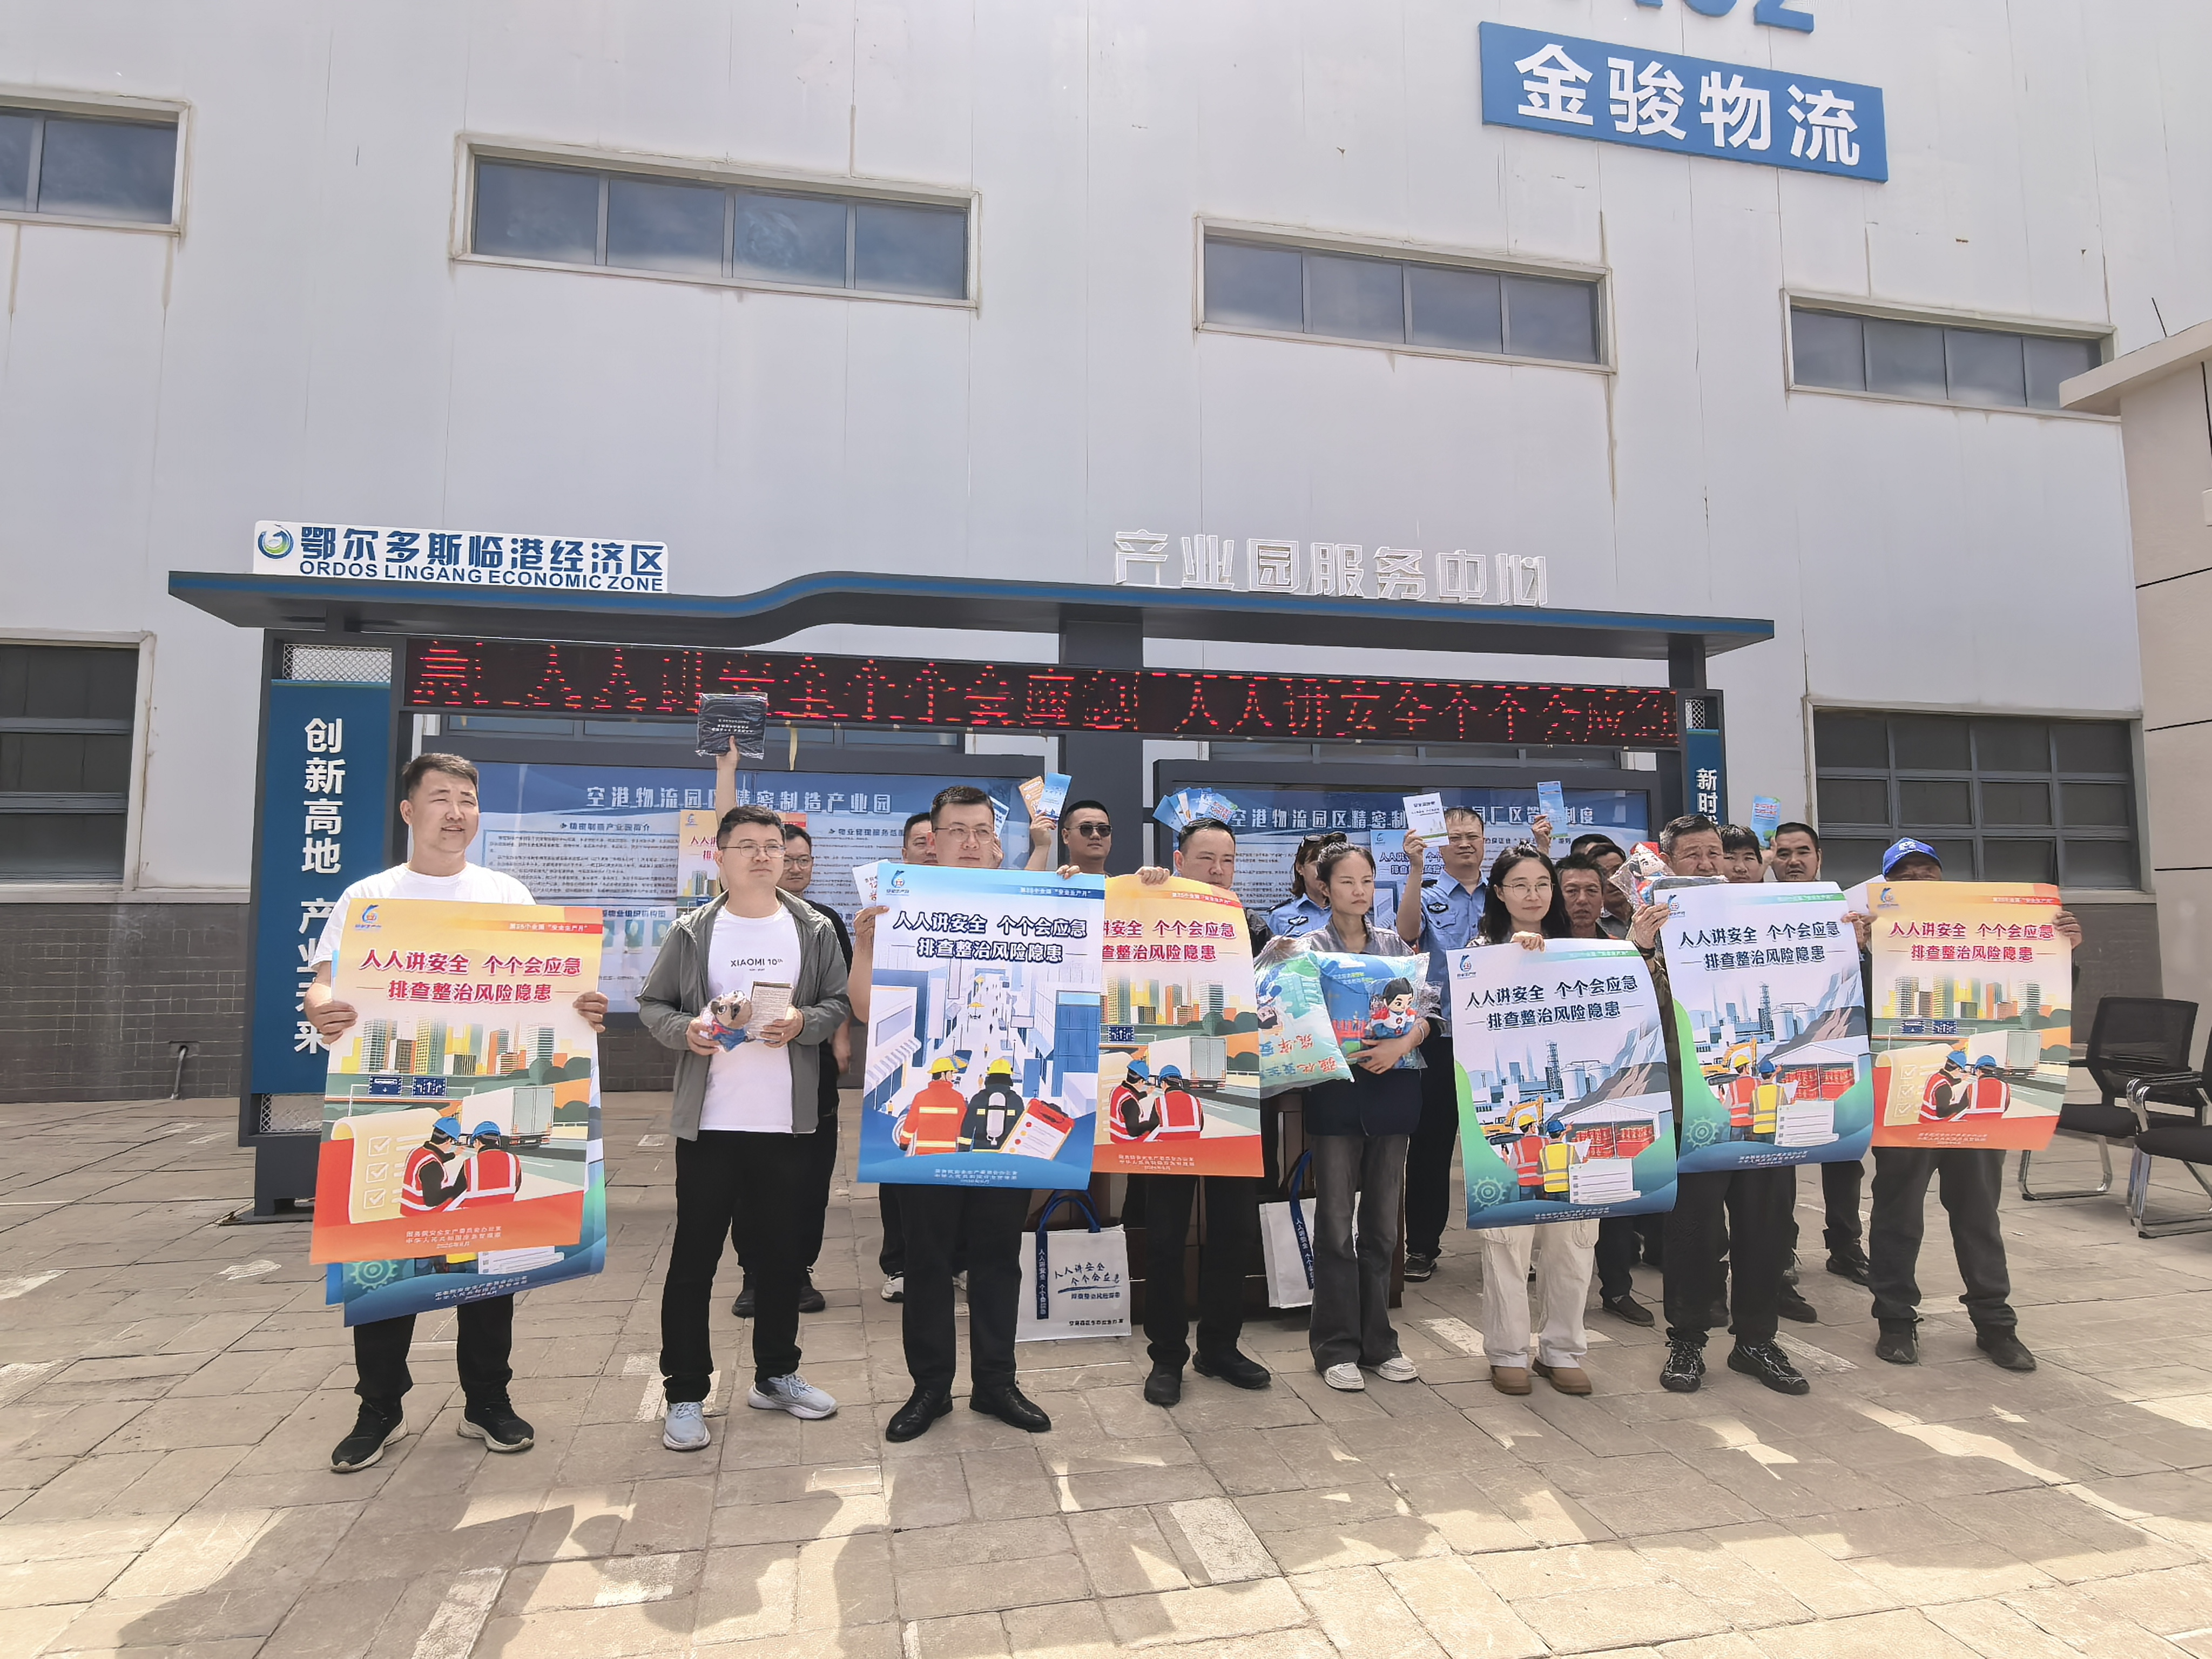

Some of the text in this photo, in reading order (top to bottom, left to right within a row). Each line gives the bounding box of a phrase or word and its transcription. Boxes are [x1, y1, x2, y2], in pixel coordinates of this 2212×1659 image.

[1514, 43, 1860, 166] 金骏物流
[300, 526, 664, 576] 鄂尔多斯临港经济区
[300, 561, 663, 591] ORDOS LINGANG ECONOMIC ZONE
[1114, 529, 1549, 607] 产业园服务中心
[301, 718, 346, 874] 创新高地
[894, 911, 1088, 938] 人人讲安全 个个会应急
[1154, 920, 1236, 938] 个个会应急
[1679, 921, 1840, 949] 人人讲安全 个个会应急
[1890, 922, 2054, 940] 人人讲安全 个个会应急
[360, 949, 583, 976] 人人讲安全 个个会应急
[731, 958, 765, 967] XIAOMI
[917, 938, 1063, 963] 排查整治风险隐患
[1704, 945, 1825, 970] 排查整治风险隐患
[1911, 945, 2033, 962] 排查整治风险隐患
[388, 980, 552, 1003] 排查整治风险隐患
[1465, 975, 1637, 1009] 人人讲安全 个个会应急
[1487, 1001, 1621, 1030] 排查整治风险隐患
[1055, 1262, 1105, 1279] 人人讲安全
